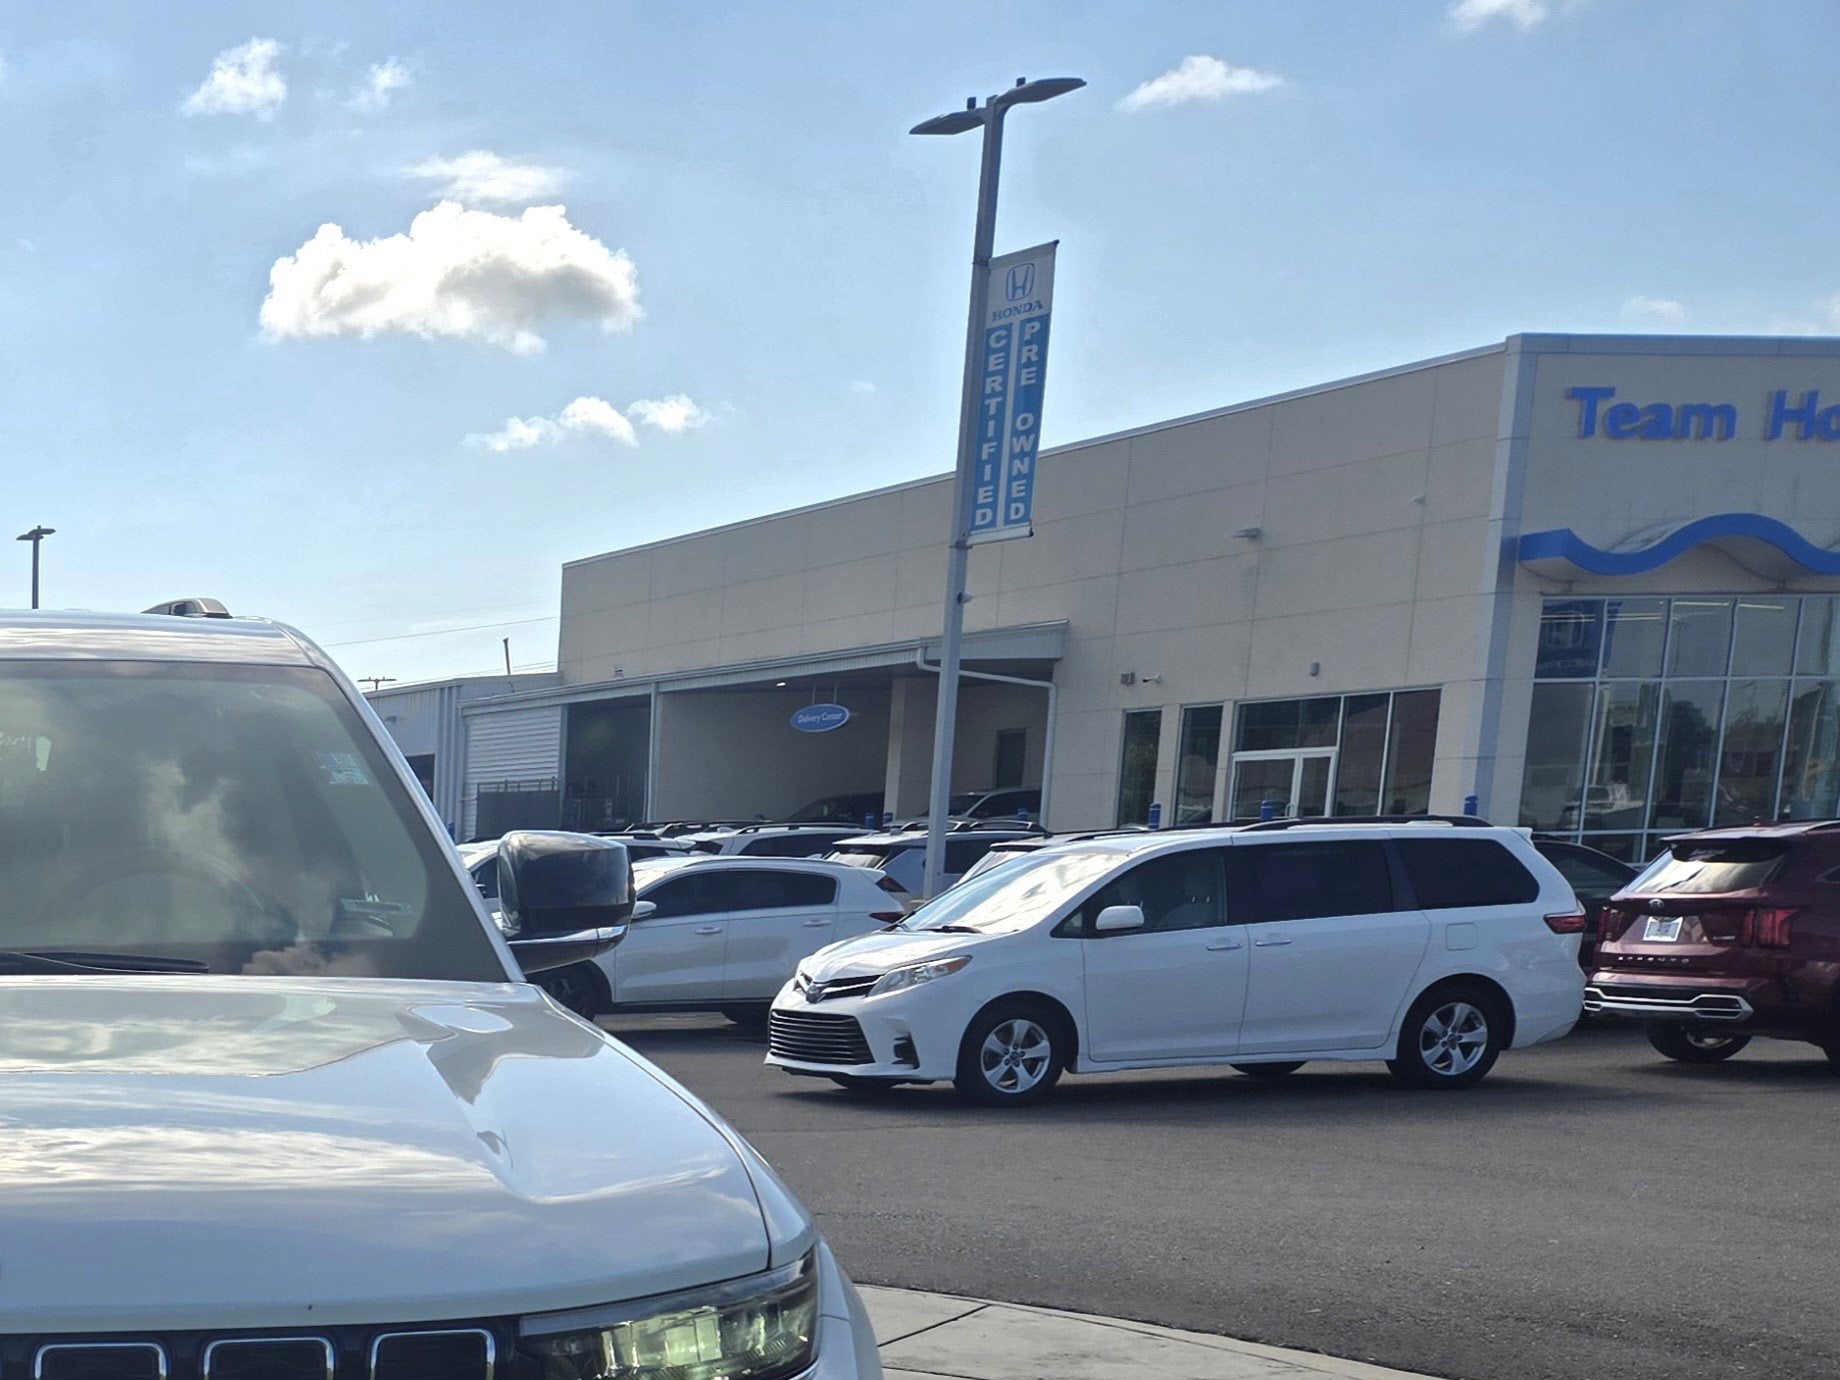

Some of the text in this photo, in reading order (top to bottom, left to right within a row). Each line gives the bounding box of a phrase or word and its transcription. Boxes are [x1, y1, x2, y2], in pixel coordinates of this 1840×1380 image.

[991, 300, 1044, 322] HONDA
[975, 329, 1008, 527] CERTIFIED
[1010, 320, 1041, 521] PRE OWNED
[1566, 386, 1738, 440] Team
